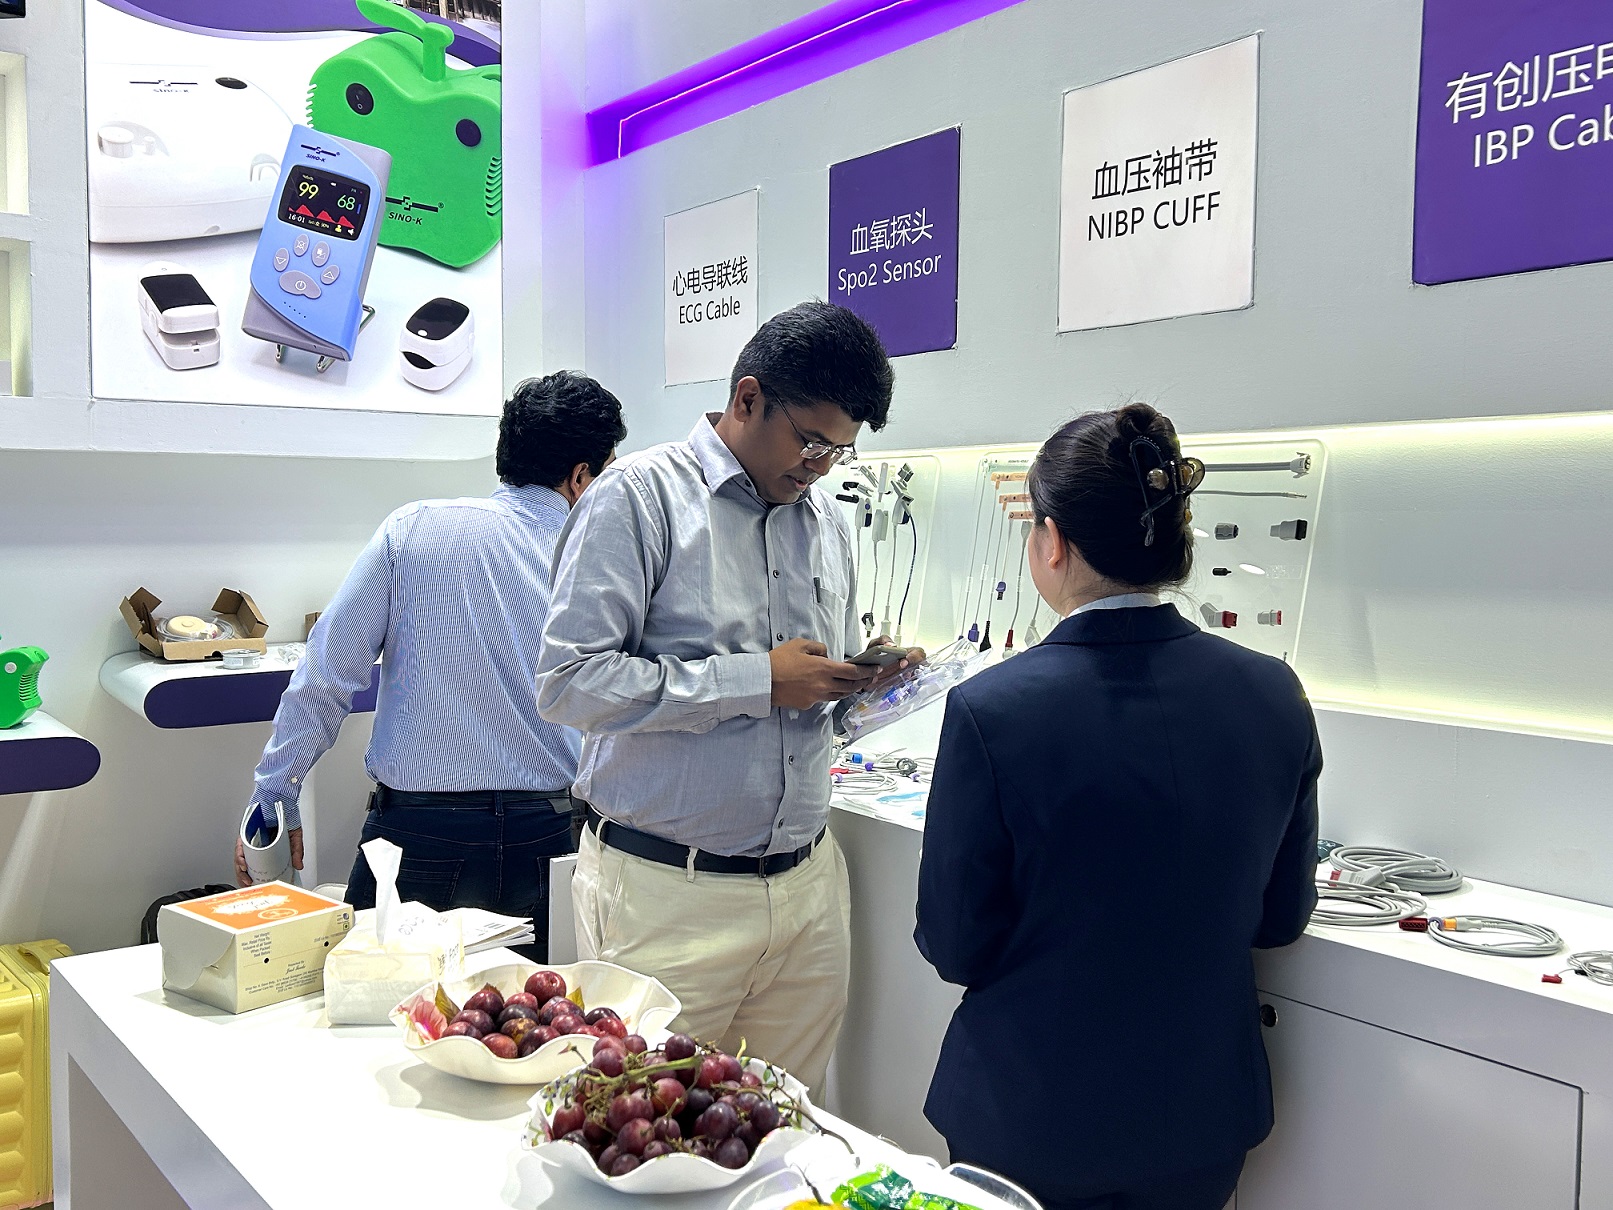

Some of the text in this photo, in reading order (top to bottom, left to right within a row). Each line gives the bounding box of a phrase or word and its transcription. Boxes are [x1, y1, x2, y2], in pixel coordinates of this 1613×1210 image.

[1474, 123, 1534, 168] IBP
[1091, 137, 1219, 200] 血压袖带
[298, 181, 356, 211] 99 68
[1088, 190, 1221, 242] NIBP CUFF
[388, 211, 423, 226] SINO-K
[849, 207, 934, 255] 血氧探头
[672, 255, 748, 297] 心电导联线
[838, 254, 942, 296] Spo2 Sensor
[680, 295, 741, 324] ECG Cable
